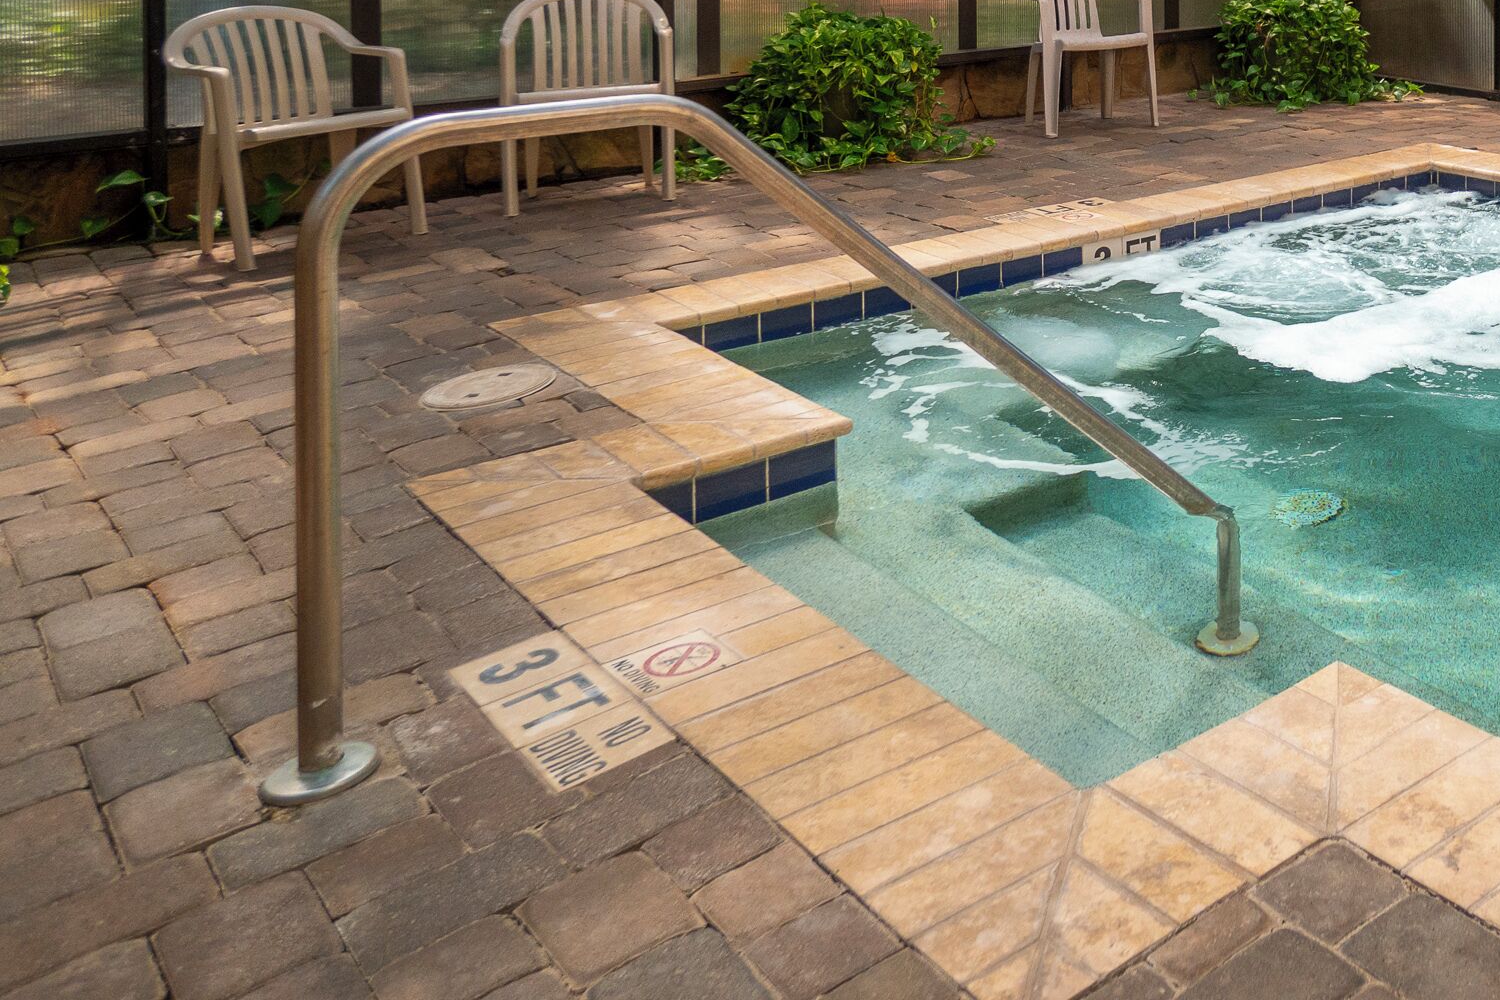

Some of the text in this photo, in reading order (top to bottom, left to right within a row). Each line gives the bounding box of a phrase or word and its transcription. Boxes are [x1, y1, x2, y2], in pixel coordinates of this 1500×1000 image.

[478, 647, 611, 730] 3 FT
[611, 659, 661, 693] NO DIVING
[597, 715, 652, 749] NO
[529, 729, 609, 788] DIVING
